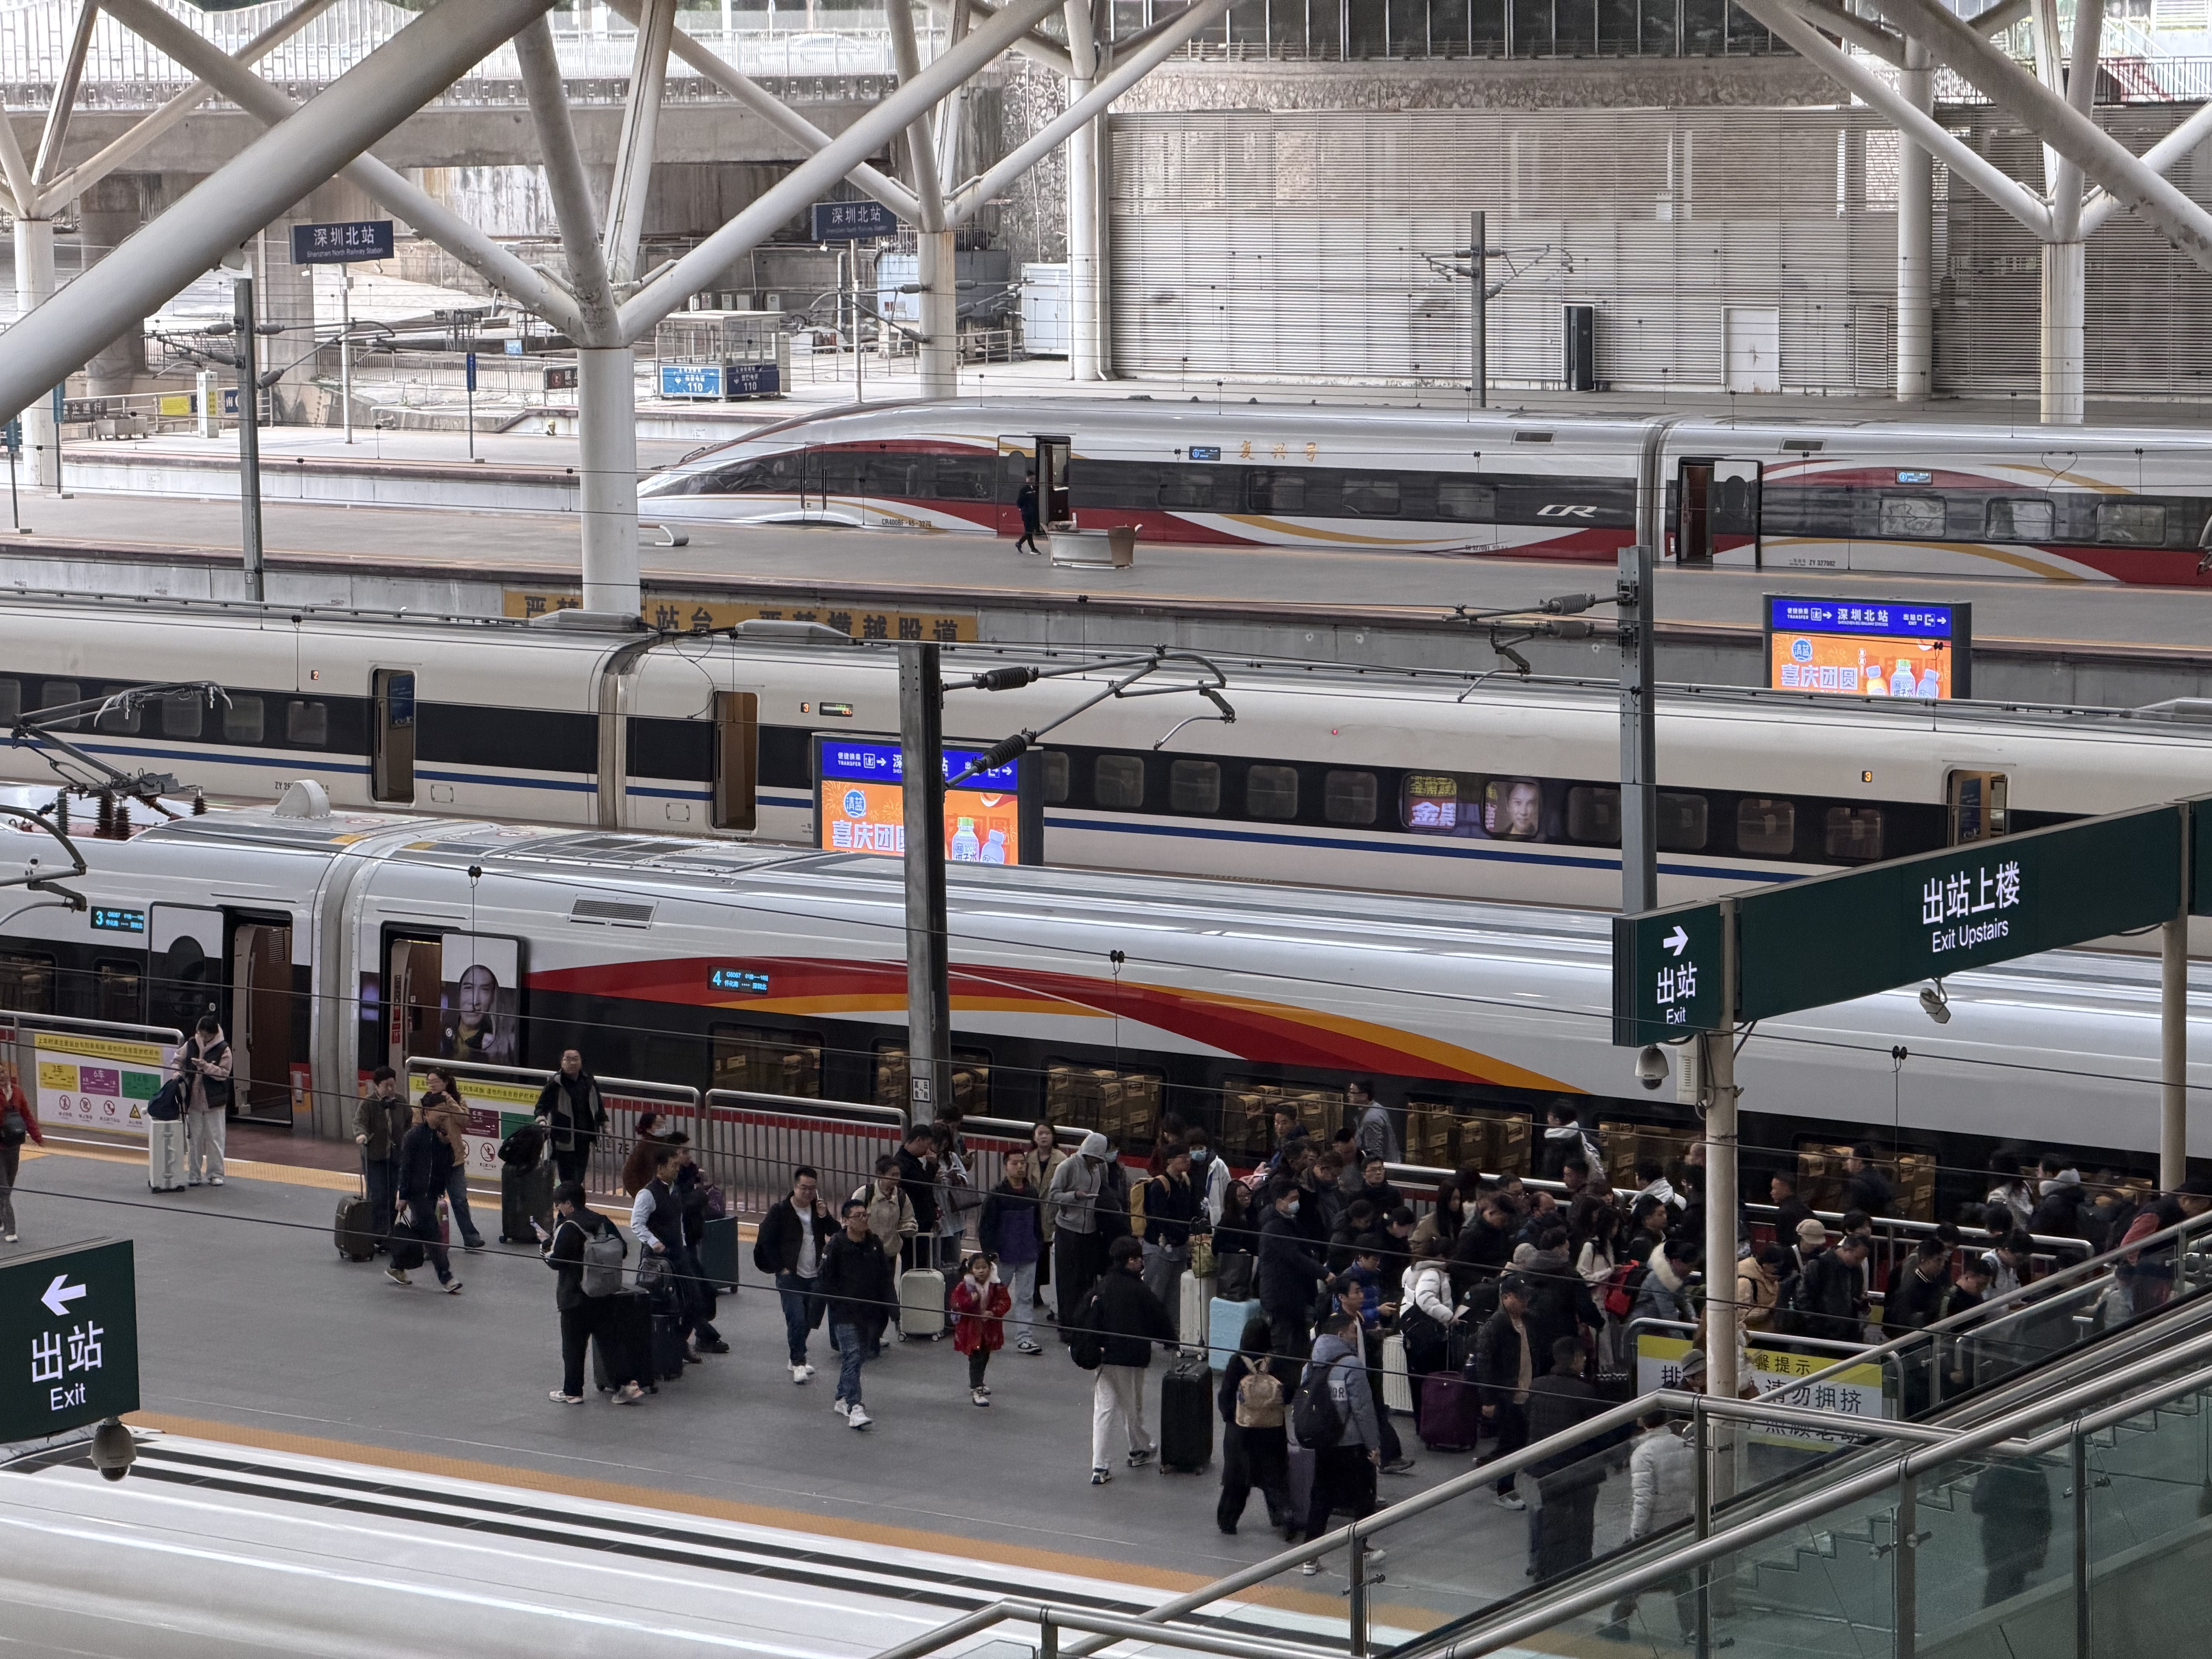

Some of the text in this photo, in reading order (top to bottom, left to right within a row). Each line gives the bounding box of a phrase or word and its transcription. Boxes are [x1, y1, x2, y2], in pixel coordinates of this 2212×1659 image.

[832, 206, 881, 224] 深圳北站
[314, 225, 374, 247] 深圳北站
[688, 383, 703, 392] 110
[744, 381, 757, 391] 110
[1239, 440, 1318, 462] 复兴号
[1537, 505, 1597, 517] CR
[881, 519, 932, 527] CR400BF-AS-3270
[1838, 608, 1889, 622] 深圳北站
[1794, 644, 1810, 657] 清蓝
[314, 671, 318, 680] 2
[1781, 663, 1858, 690] 喜庆团圆
[804, 699, 809, 708] 3
[1865, 772, 1871, 782] 3
[275, 781, 282, 790] ZY
[846, 796, 864, 811] 清蓝
[1923, 860, 2020, 924] 出站上楼
[96, 910, 103, 925] 3
[1933, 917, 2009, 953] Exit Upstairs
[713, 971, 721, 986] 4
[1657, 961, 1697, 1004] 出站
[1666, 1006, 1686, 1024] Exit
[32, 1321, 104, 1382] 出站
[1755, 1354, 1810, 1375] 馨提示
[50, 1382, 86, 1410] Exit
[1767, 1379, 1862, 1414] 请勿拥挤
